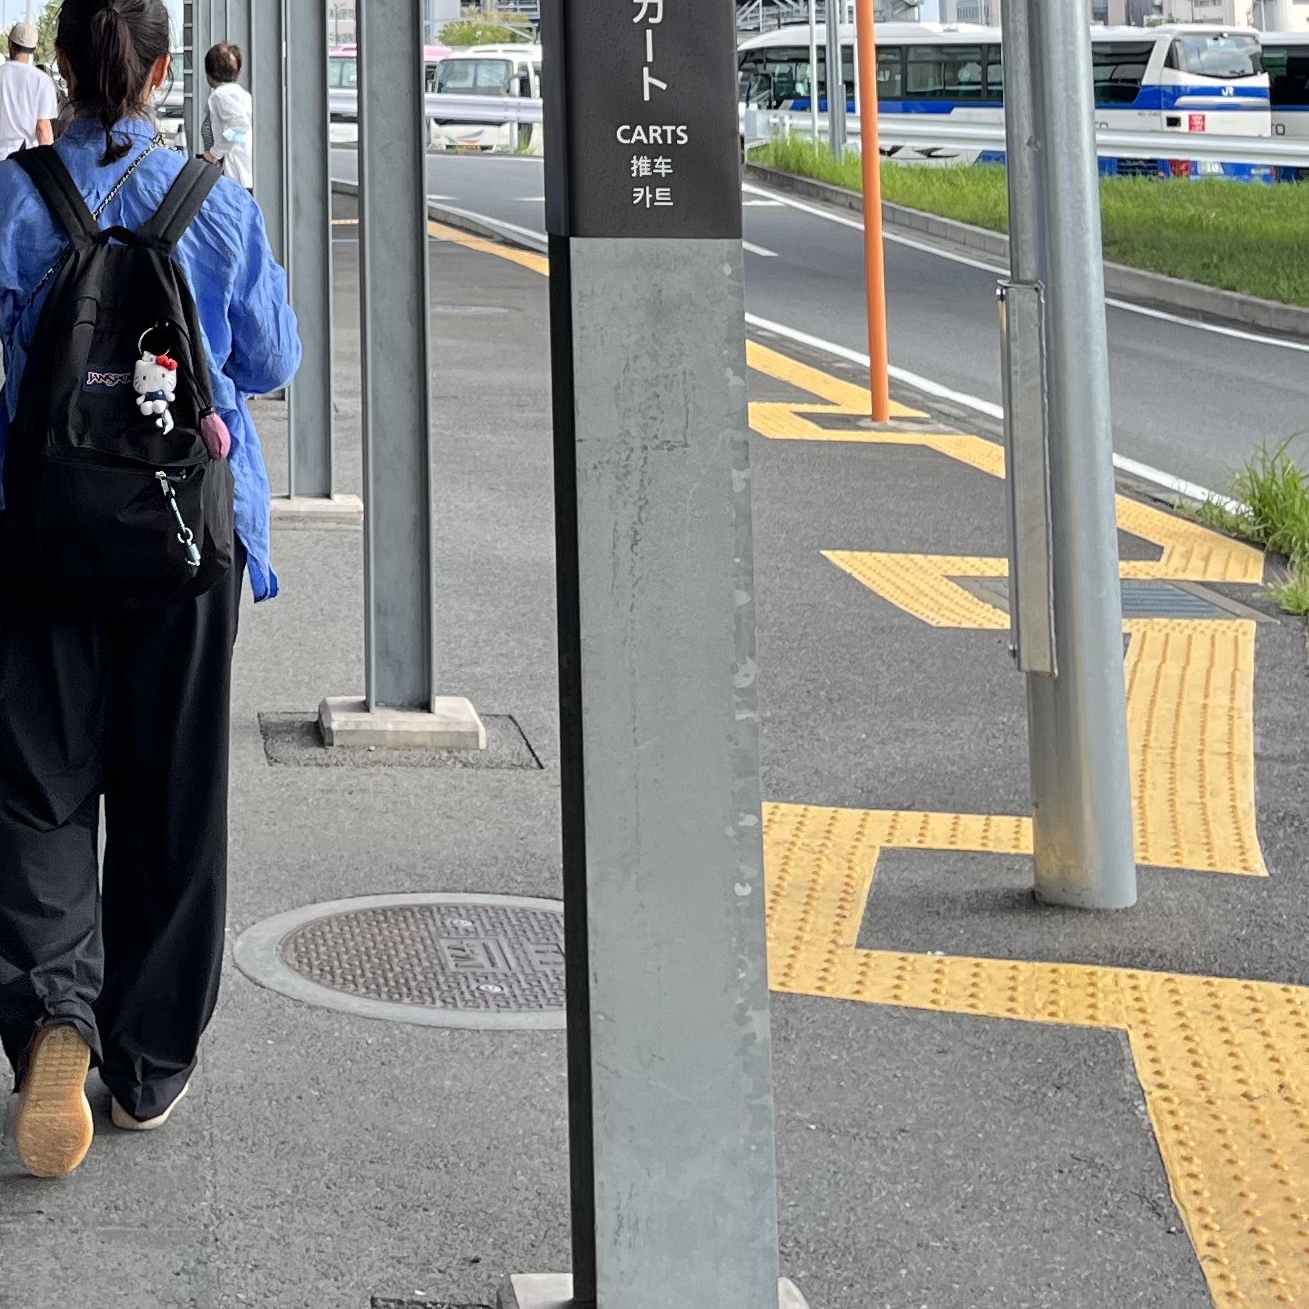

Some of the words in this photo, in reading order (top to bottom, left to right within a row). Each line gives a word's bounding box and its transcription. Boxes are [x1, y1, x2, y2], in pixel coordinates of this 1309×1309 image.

[616, 124, 689, 145] CARTS
[630, 155, 673, 178] 推车
[632, 185, 674, 209] 카트
